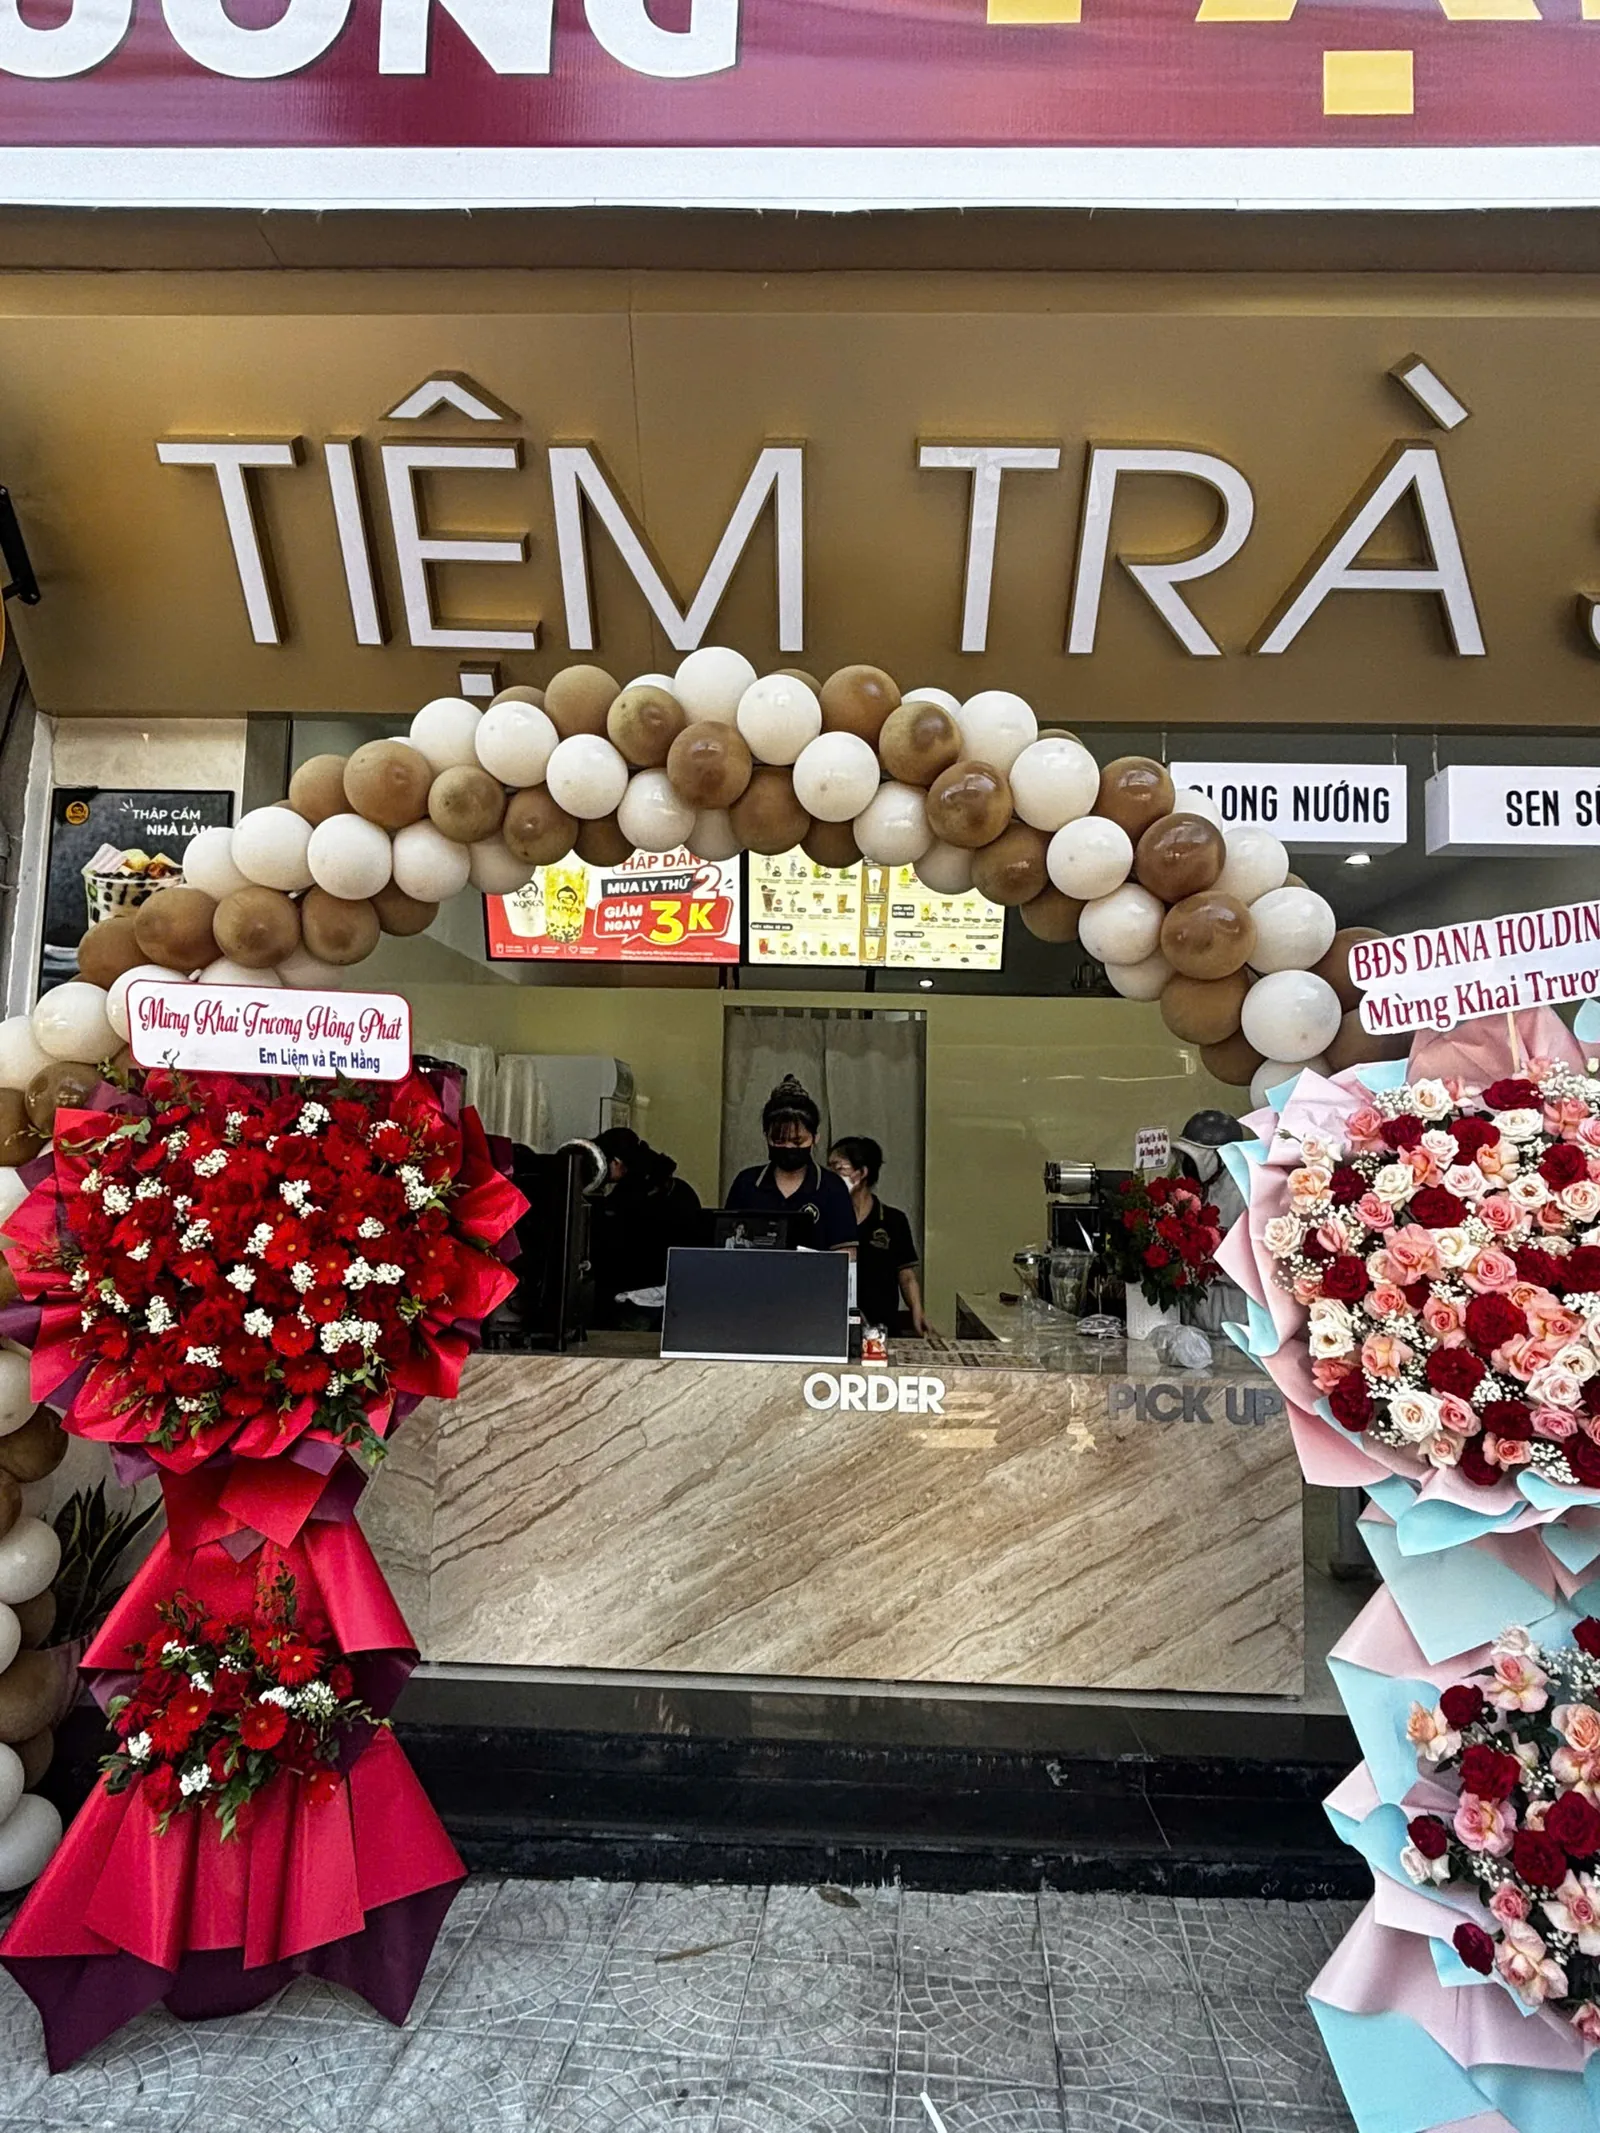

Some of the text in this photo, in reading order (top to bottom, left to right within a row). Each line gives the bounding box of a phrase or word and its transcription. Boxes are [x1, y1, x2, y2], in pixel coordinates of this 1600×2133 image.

[154, 355, 1488, 697] TIỆM TRÀ
[132, 806, 201, 822] THẬP CẤM
[1293, 780, 1390, 824] NƯỚNG
[1506, 790, 1560, 827] SEN
[146, 821, 179, 836] NHÀ
[606, 865, 719, 899] MUA LY THỨ 2
[604, 901, 643, 918] GIẢM
[604, 919, 641, 932] NGAY
[1353, 903, 1600, 982] BĐS DANA HOLDIN
[138, 996, 190, 1038] Mừng
[194, 999, 241, 1035] Khai
[306, 1005, 355, 1047] Hồng
[359, 1007, 403, 1043] Phát
[1366, 992, 1448, 1031] Mừng
[1454, 974, 1520, 1016] Khai
[259, 1047, 278, 1064] Em
[312, 1049, 326, 1067] và
[329, 1051, 348, 1068] Em
[351, 1048, 380, 1074] Hằng
[803, 1372, 946, 1414] ORDER
[1108, 1383, 1284, 1425] PICK UP
